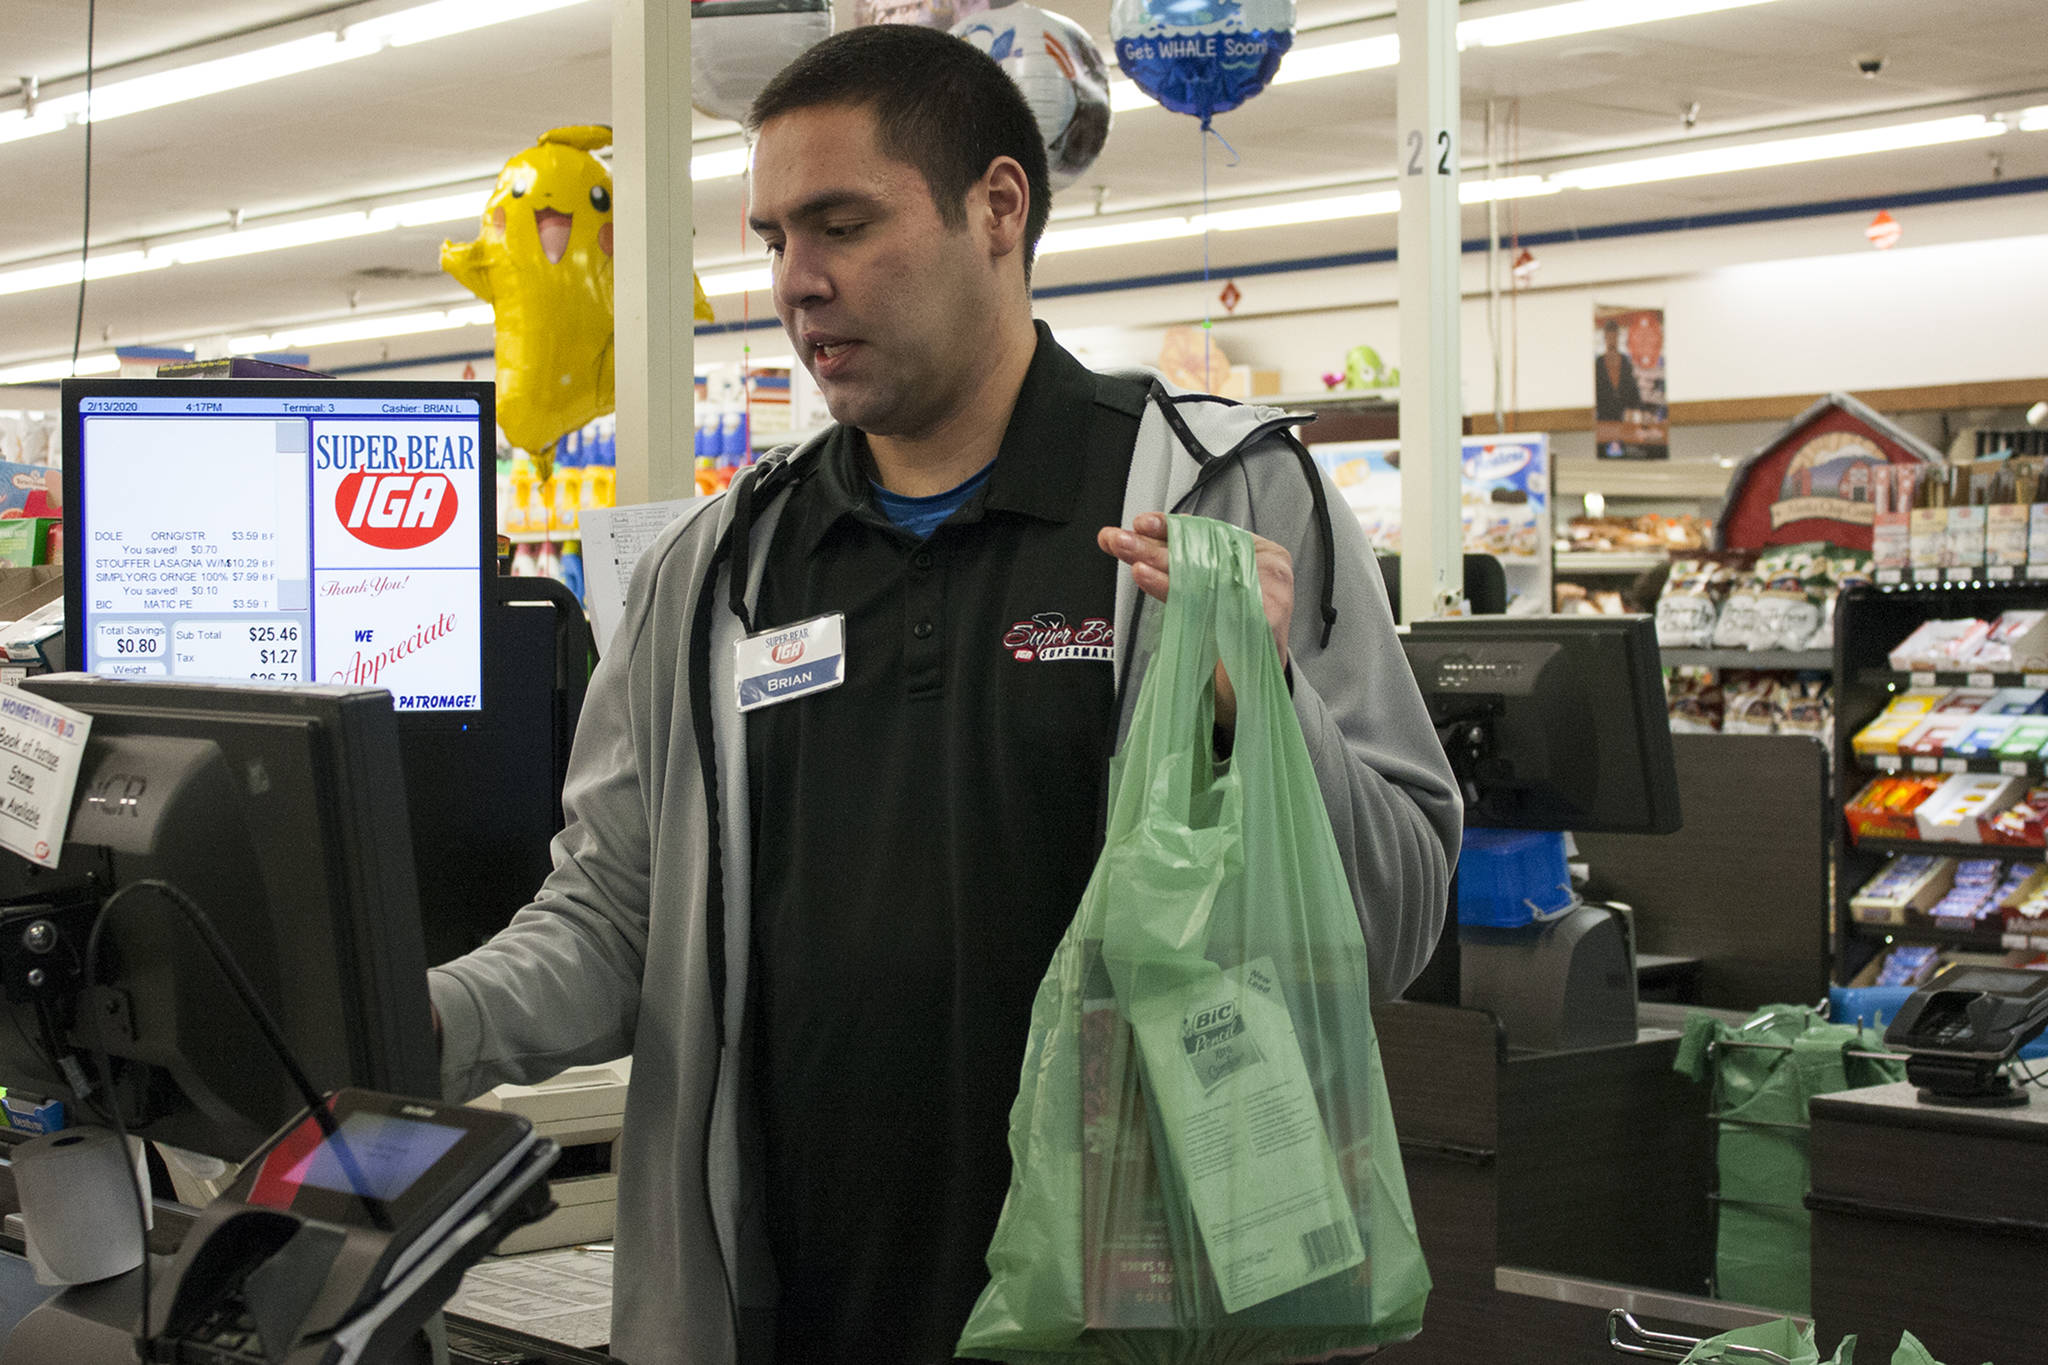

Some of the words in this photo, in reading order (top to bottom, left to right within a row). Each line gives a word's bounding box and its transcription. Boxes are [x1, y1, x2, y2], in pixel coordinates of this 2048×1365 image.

[1124, 43, 1154, 60] Get
[1158, 38, 1217, 59] WHALE
[1224, 38, 1268, 57] Soon!
[1407, 129, 1424, 176] 2
[1437, 129, 1451, 176] 2
[87, 402, 138, 412] 2/13/2020
[185, 402, 223, 412] 4:17PM
[282, 402, 326, 412] Terminal:
[328, 402, 335, 412] 3
[381, 403, 420, 413] Cashier:
[423, 404, 453, 413] BRIAN
[456, 404, 461, 413] L
[316, 434, 399, 470] SUPER
[407, 435, 475, 470] BEAR
[347, 476, 448, 528] IGA
[95, 531, 123, 541] DOLE
[151, 531, 206, 541] ORNG/STR
[231, 531, 258, 541] $3.59
[122, 545, 142, 555] You
[145, 545, 178, 555] saved!
[191, 545, 218, 555] $0.70
[96, 559, 150, 569] STOUFFER
[154, 559, 203, 569] LASAGNA
[96, 573, 157, 582] SIMPLYORG
[160, 573, 197, 582] ORNGE
[201, 573, 228, 582] 100%
[232, 573, 259, 582] $7.99
[122, 586, 142, 595] You
[145, 586, 178, 595] saved!
[191, 586, 218, 595] $0.10
[320, 578, 368, 597] Thank
[369, 575, 410, 597] You!
[96, 600, 113, 609] BIC
[144, 600, 176, 609] MATIC
[179, 600, 193, 609] PE
[232, 600, 259, 609] $3.59
[100, 626, 124, 635] Total
[127, 626, 165, 637] Savings
[176, 631, 195, 640] Sub
[197, 630, 222, 640] Total
[249, 627, 298, 642] $25.46
[354, 630, 374, 642] WE
[765, 633, 789, 648] SUPER
[789, 628, 809, 641] BEAR
[1003, 624, 1072, 654] Super
[116, 638, 157, 653] $0.80
[329, 612, 457, 686] Appreciate
[775, 640, 802, 661] IGA
[1041, 647, 1114, 659] SUPERMAR
[176, 653, 195, 662] Tax
[260, 649, 298, 664] $1.27
[113, 665, 147, 675] Weight
[767, 671, 812, 692] BRIAN
[399, 695, 477, 709] PATRONAGE!
